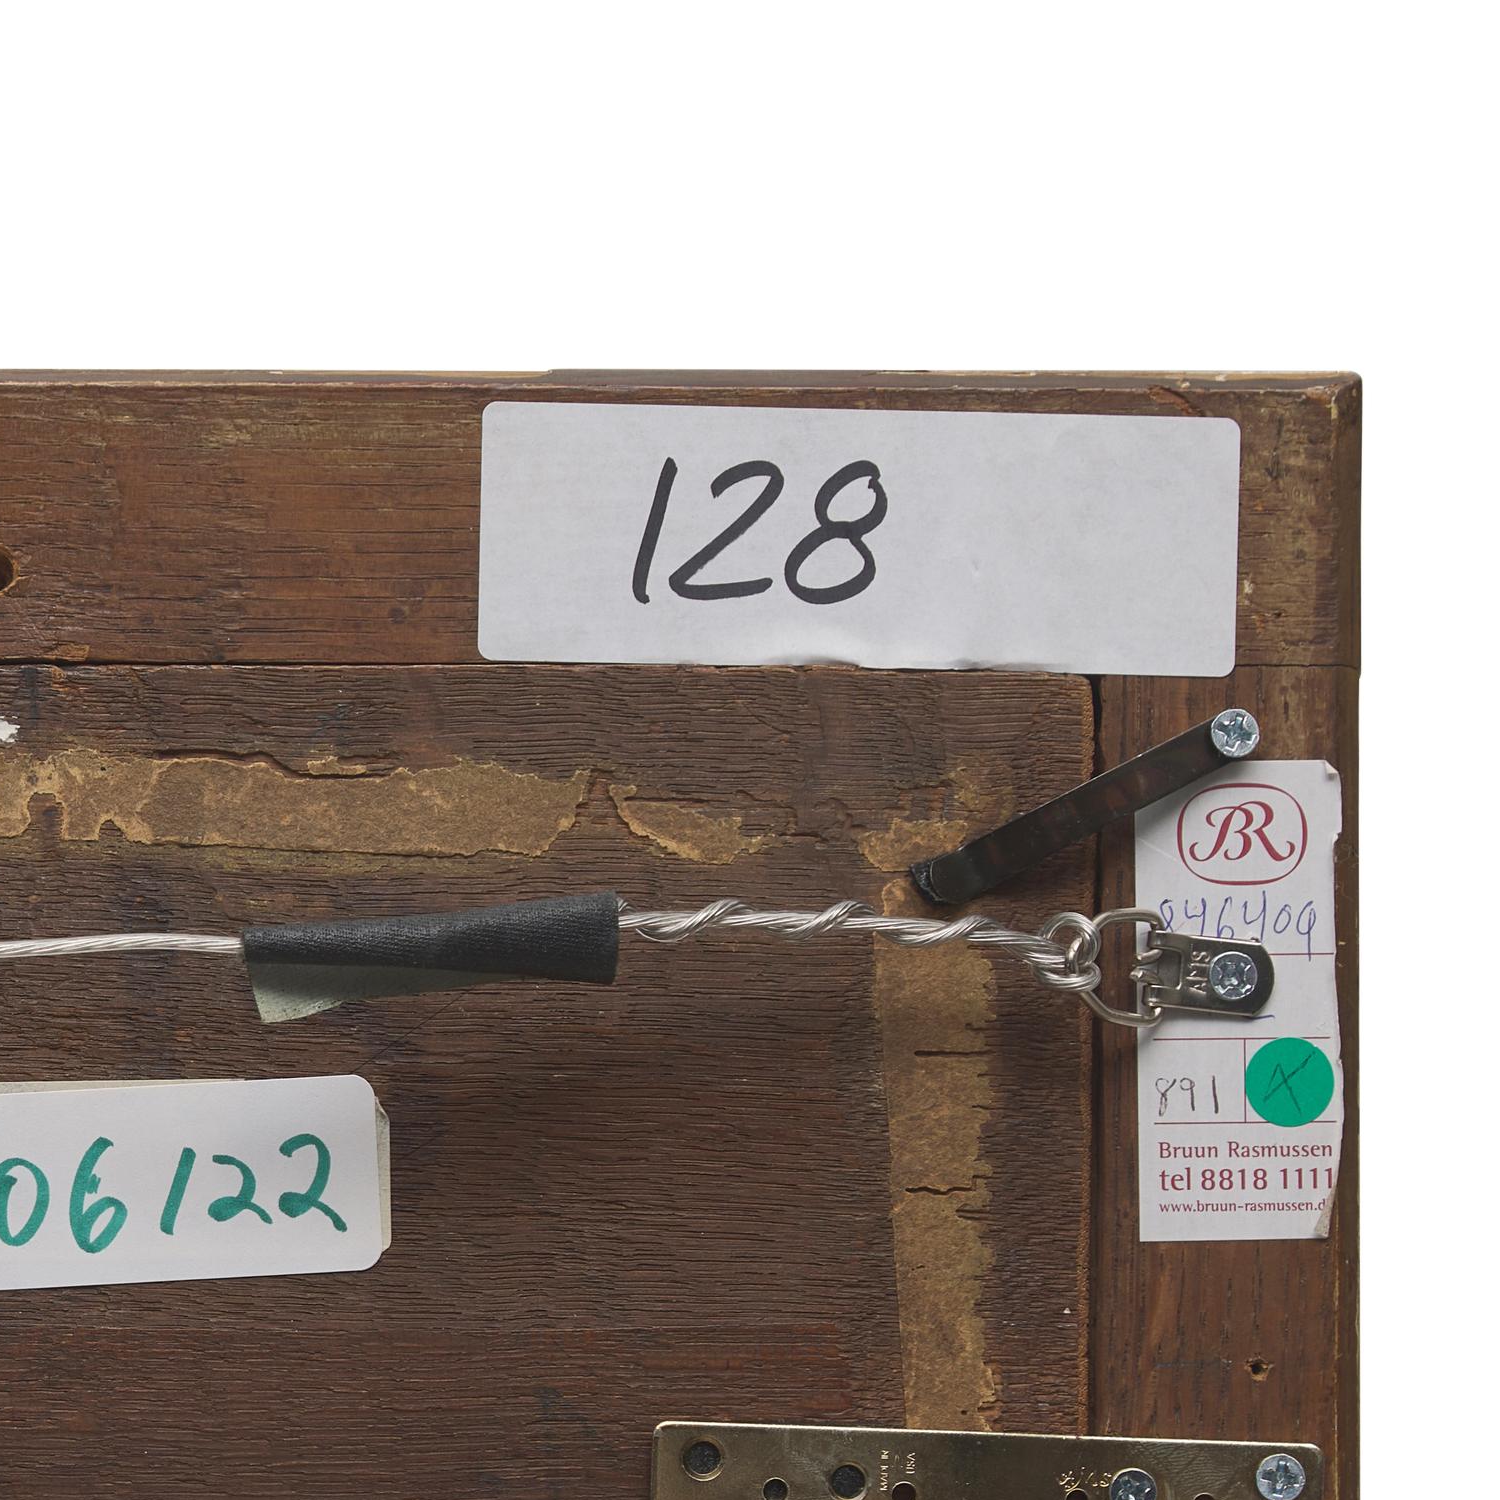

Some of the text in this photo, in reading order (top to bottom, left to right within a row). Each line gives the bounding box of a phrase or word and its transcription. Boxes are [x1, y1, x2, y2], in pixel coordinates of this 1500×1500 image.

[632, 456, 889, 605] 128
[1158, 1140, 1333, 1159] Bruun Rasmussen
[1159, 1166, 1333, 1191] tel 8818 1111
[905, 1452, 916, 1474] USA
